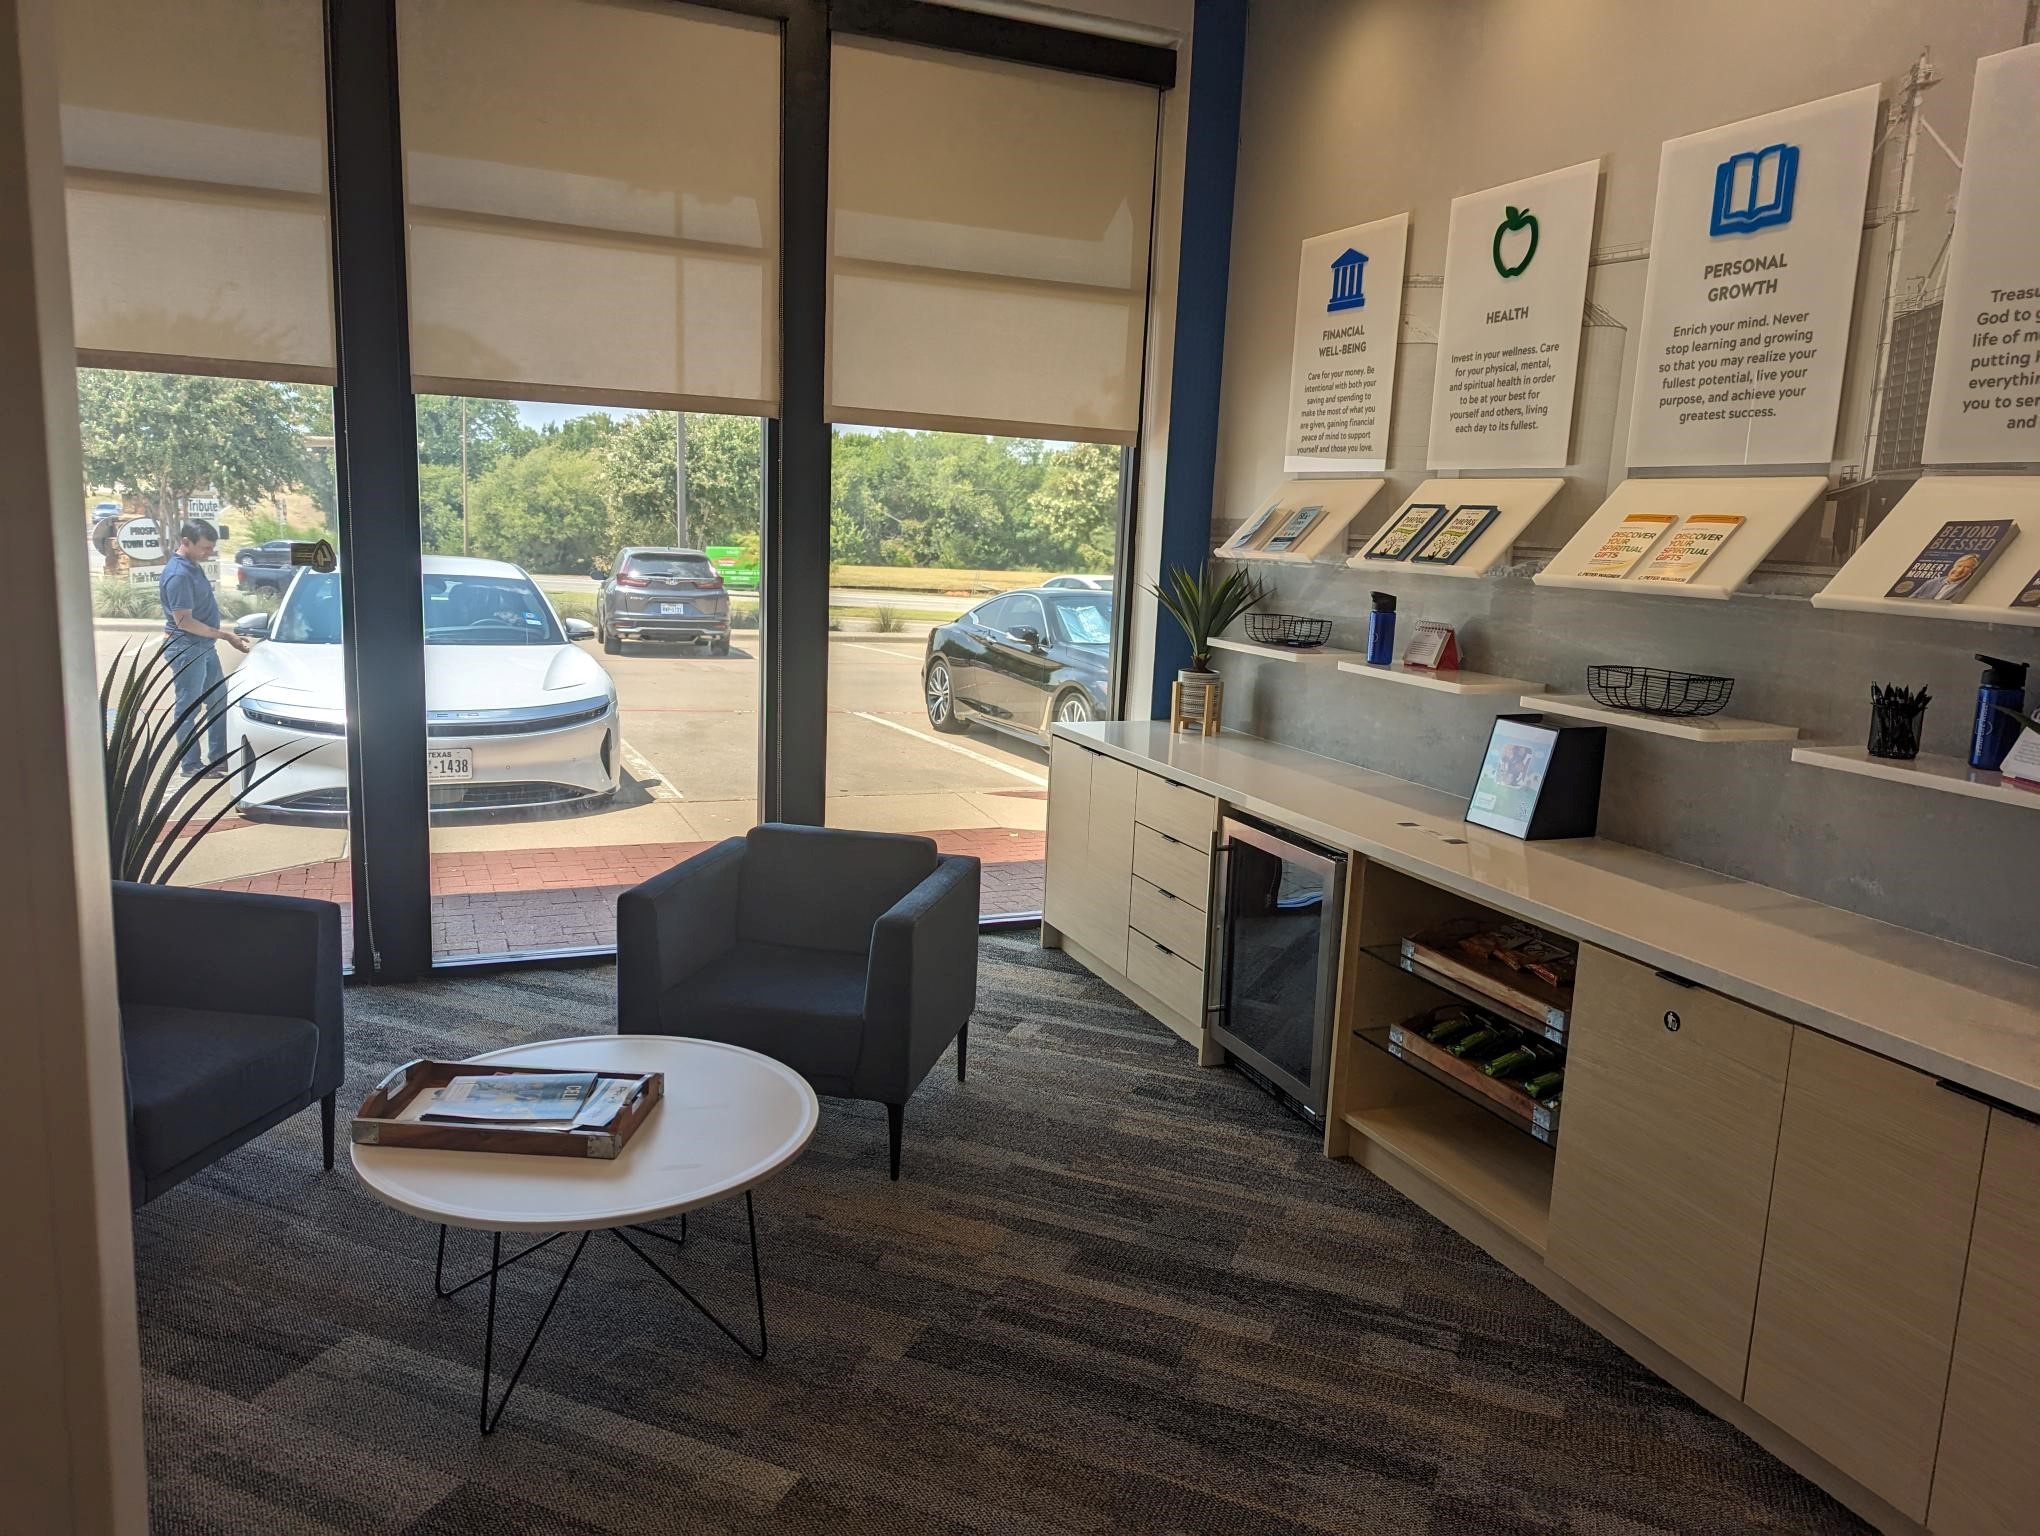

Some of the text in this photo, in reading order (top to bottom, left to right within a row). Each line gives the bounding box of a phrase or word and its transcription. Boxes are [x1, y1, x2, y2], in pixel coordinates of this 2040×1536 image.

[1704, 253, 1788, 280] PERSONAL
[1708, 279, 1777, 302] GROWTH
[1486, 306, 1529, 324] HEALTH
[1977, 309, 2010, 325] God
[2015, 310, 2031, 322] to
[1673, 312, 1809, 337] Enrich your mind. Never
[1323, 325, 1365, 341] FINANCIAL
[1972, 334, 1998, 347] life
[2002, 329, 2020, 344] of
[1319, 342, 1366, 357] WELL-BEING
[1665, 329, 1813, 356] stop learning and growing
[1452, 342, 1559, 363] Invest in your wellness. Care
[1455, 358, 1551, 377] for your physical, mental,
[1659, 349, 1817, 373] so that you may realize your
[1971, 352, 2030, 371] putting
[1308, 372, 1320, 380] Care
[1331, 371, 1342, 381] your
[1345, 368, 1365, 378] money.
[1367, 366, 1374, 374] Be
[1662, 368, 1808, 389] fullest potential, live your
[1305, 379, 1376, 393] intentional with both your
[1449, 373, 1556, 391] and spiritual health in order
[1307, 396, 1324, 405] saving
[1325, 395, 1335, 404] and
[1337, 392, 1363, 405] spending
[1460, 390, 1540, 405] to be at your best for
[1659, 386, 1806, 408] purpose, and achieve your
[1963, 398, 1989, 413] you
[1995, 397, 2011, 408] to
[1301, 409, 1315, 417] make
[1317, 408, 1325, 416] the
[1327, 408, 1341, 416] most
[1342, 406, 1348, 414] of
[1365, 406, 1375, 415] you
[1450, 405, 1548, 422] yourself and others, living
[1679, 407, 1777, 424] greatest success.
[1309, 420, 1325, 430] given,
[1327, 419, 1348, 429] gaining
[1349, 417, 1374, 426] financial
[1455, 420, 1538, 433] each day to its fullest.
[2007, 415, 2037, 429] and
[1301, 435, 1317, 443] peace
[1325, 432, 1339, 440] mind
[1348, 431, 1370, 440] support
[1297, 443, 1373, 455] yourself and those you love.
[189, 500, 218, 511] Tribute
[1940, 526, 1999, 537] BEYOND
[121, 540, 143, 548] TOWN
[1661, 547, 1709, 555] SPIRITUAL
[1930, 539, 1996, 550] BLESSED
[1913, 563, 1951, 571] ROBERT
